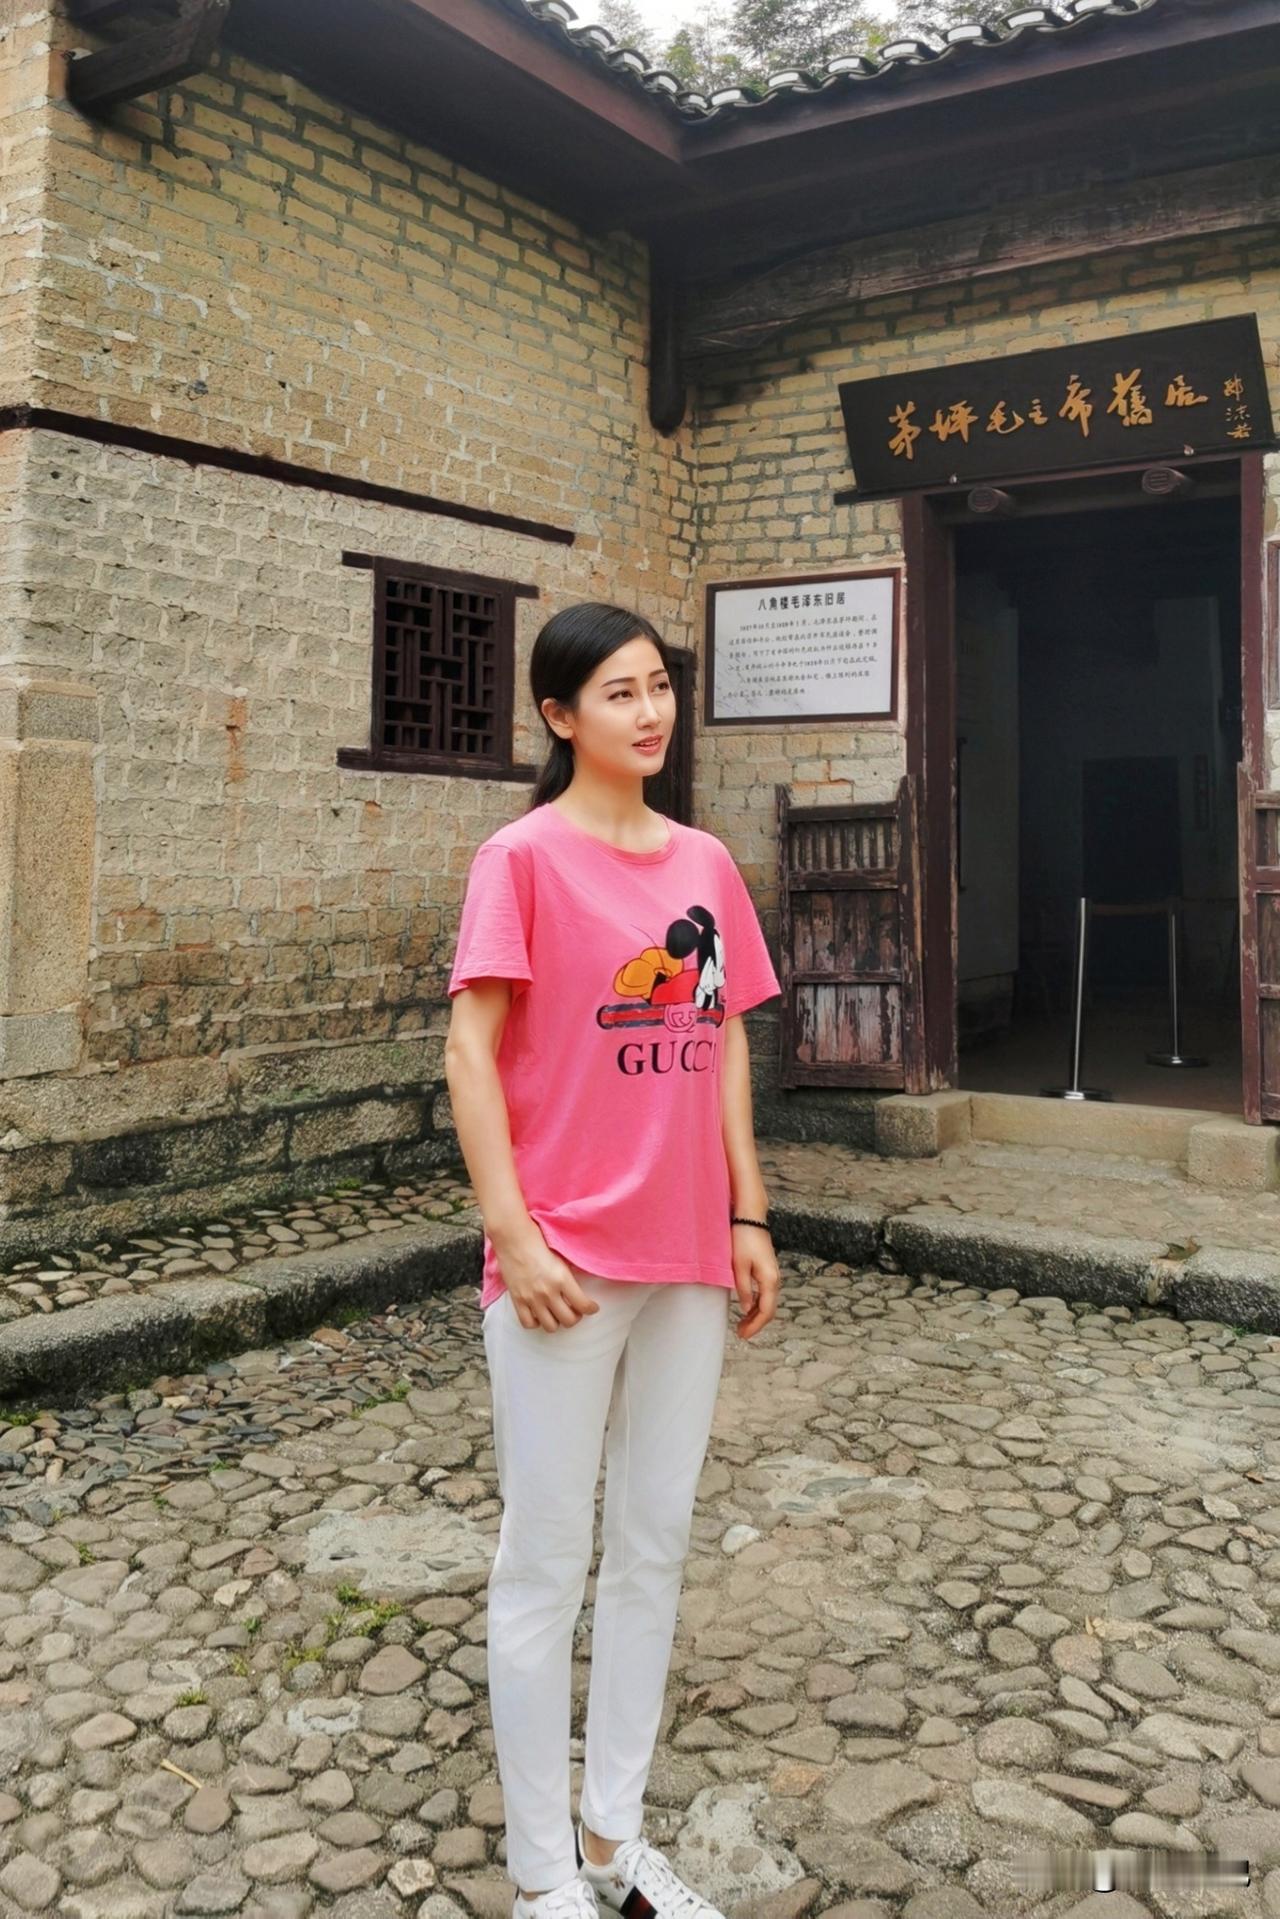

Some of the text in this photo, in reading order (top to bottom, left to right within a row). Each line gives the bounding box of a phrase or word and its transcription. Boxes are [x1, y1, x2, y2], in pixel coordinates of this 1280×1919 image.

[757, 592, 846, 611] 八角楼毛泽东旧居
